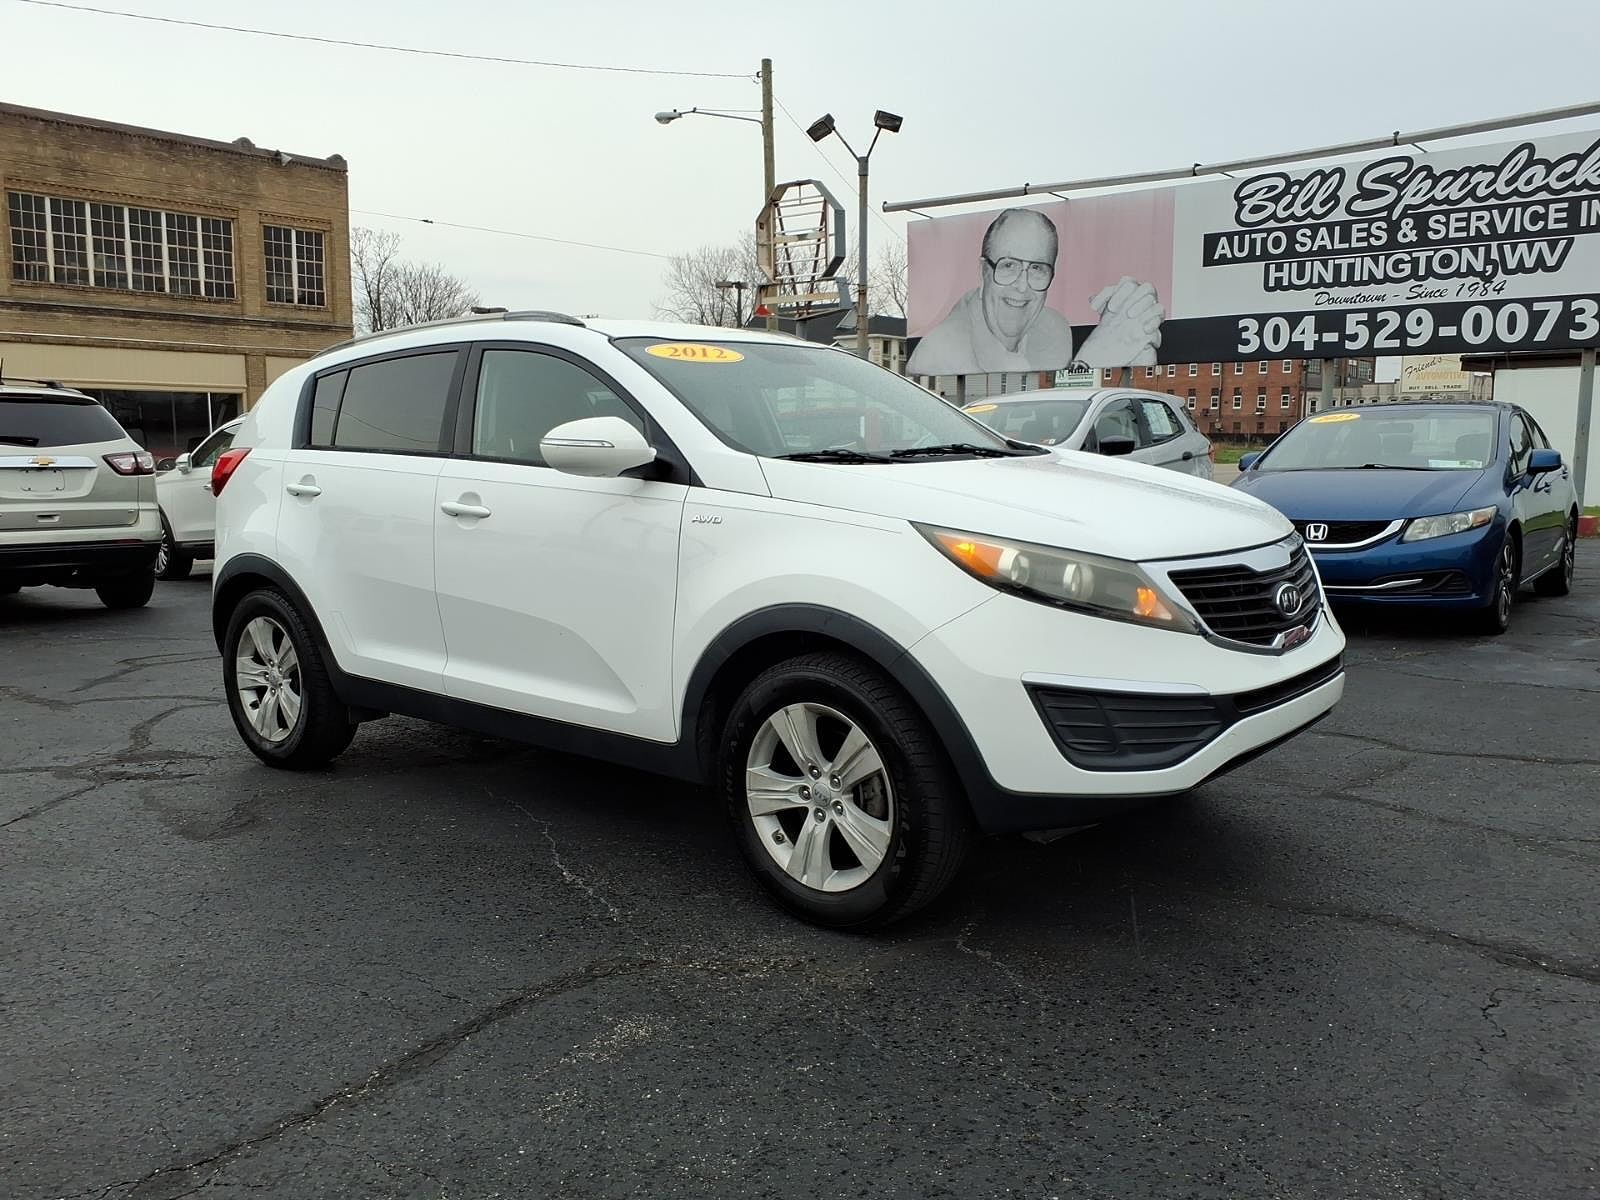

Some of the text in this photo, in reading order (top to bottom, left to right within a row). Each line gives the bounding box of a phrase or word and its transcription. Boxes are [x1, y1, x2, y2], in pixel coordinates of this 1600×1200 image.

[1236, 142, 1600, 226] Bill Spurlock
[1214, 231, 1287, 260] AUTO
[1295, 221, 1388, 252] SALES
[1397, 217, 1418, 243] &
[1427, 202, 1569, 240] SERVICE
[1268, 239, 1568, 287] HUNTINGTON, WV
[1314, 291, 1386, 306] Downtown
[1406, 284, 1448, 300] Since
[1455, 279, 1507, 297] 1984
[1237, 298, 1600, 354] 304-529-0073
[669, 346, 728, 359] 2012
[691, 514, 723, 525] AWD
